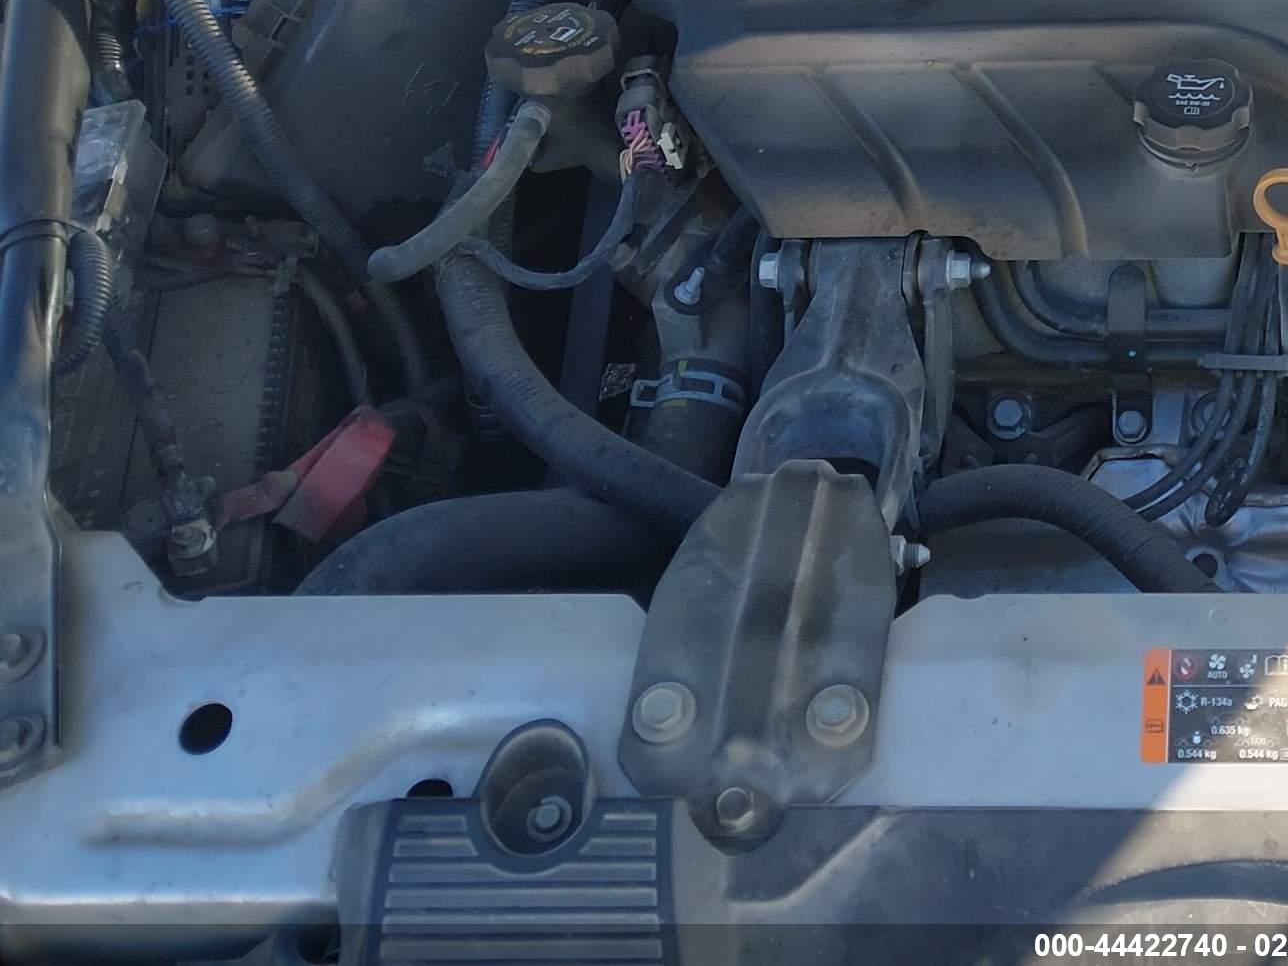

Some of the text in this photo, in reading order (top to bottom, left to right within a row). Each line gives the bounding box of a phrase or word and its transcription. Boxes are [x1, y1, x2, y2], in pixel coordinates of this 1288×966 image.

[1207, 671, 1228, 679] AUTO
[1200, 697, 1288, 708] R-134a PAG
[1211, 725, 1250, 737] 0.635 kg
[1178, 749, 1217, 761] 0.544 kg
[1239, 749, 1264, 759] 0.544
[1265, 749, 1279, 761] kg
